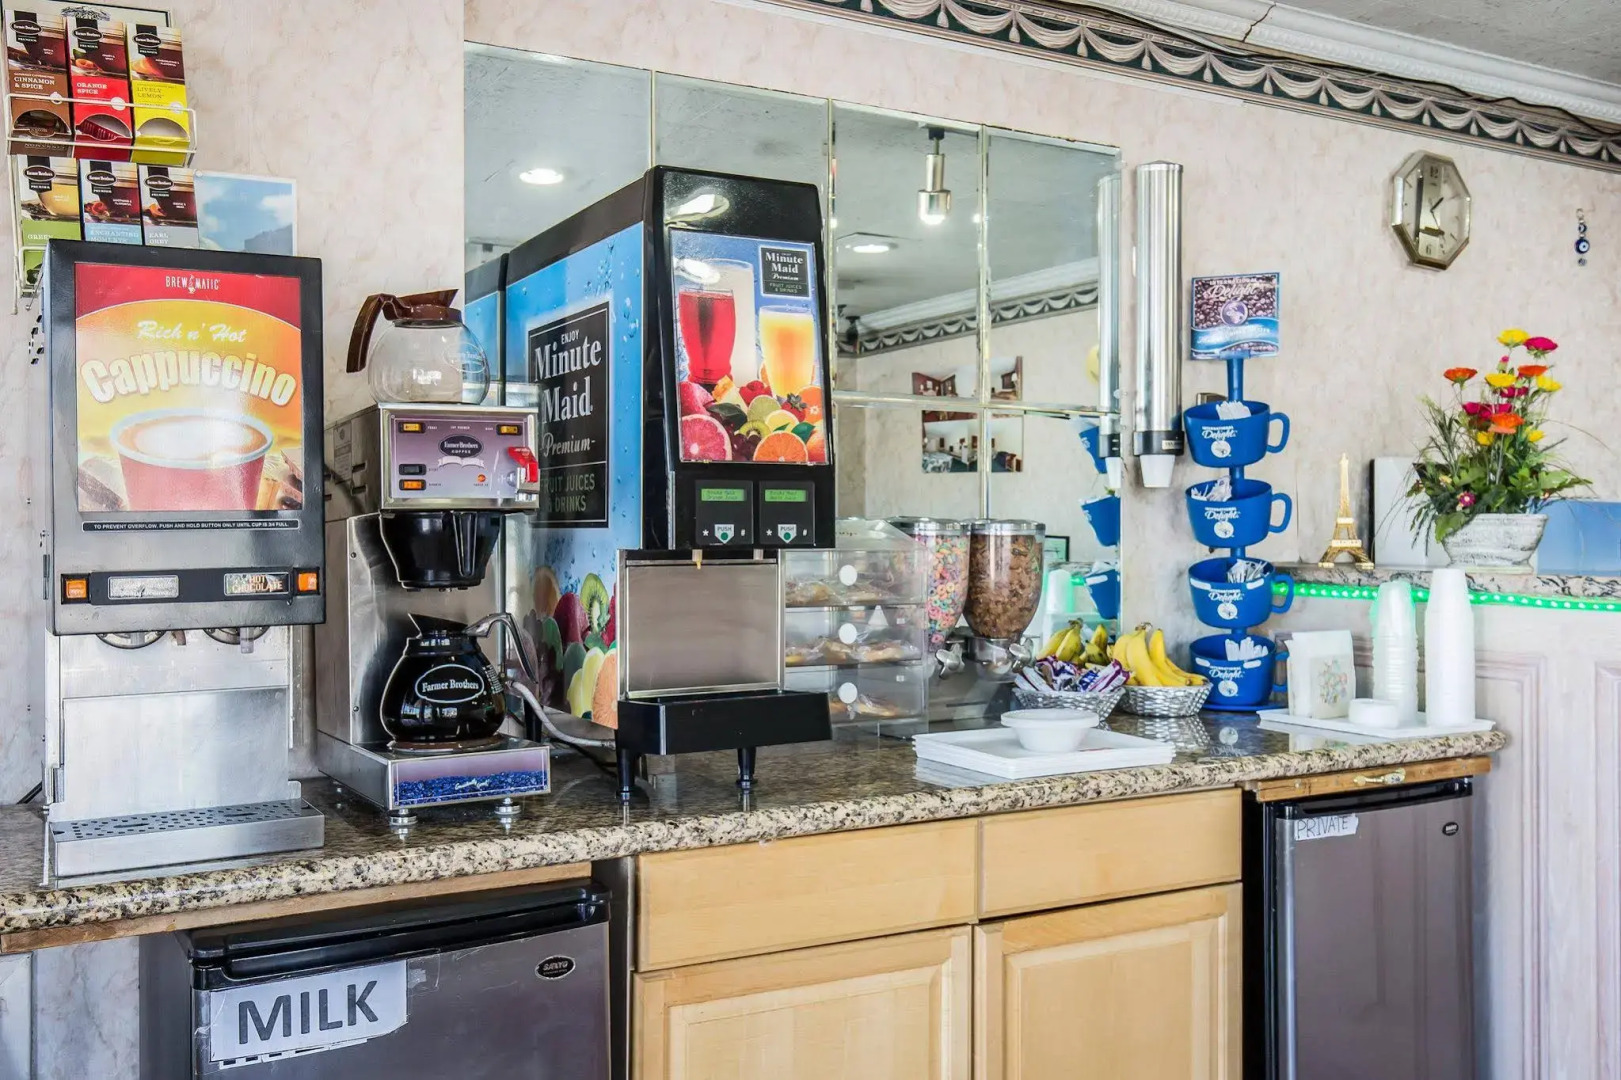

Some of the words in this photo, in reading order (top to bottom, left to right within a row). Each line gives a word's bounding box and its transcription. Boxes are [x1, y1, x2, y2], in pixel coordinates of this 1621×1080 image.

[14, 76, 55, 86] CINNAMON
[21, 82, 43, 90] SPICE
[765, 252, 804, 264] Minute
[771, 262, 799, 274] Maid
[136, 319, 183, 341] Rich
[209, 323, 247, 343] Hot
[561, 329, 580, 344] ENJOY
[534, 336, 602, 382] Minute
[80, 350, 297, 406] Cappuccino
[541, 375, 592, 424] Maid
[566, 473, 596, 492] JUICES
[555, 495, 587, 512] DRINKS
[249, 574, 265, 583] HOT
[232, 580, 283, 594] CHOCOLATE
[421, 682, 449, 693] Farmer
[450, 678, 479, 690] Brothers
[1297, 816, 1349, 839] PRIVATE
[238, 980, 379, 1045] MILK
